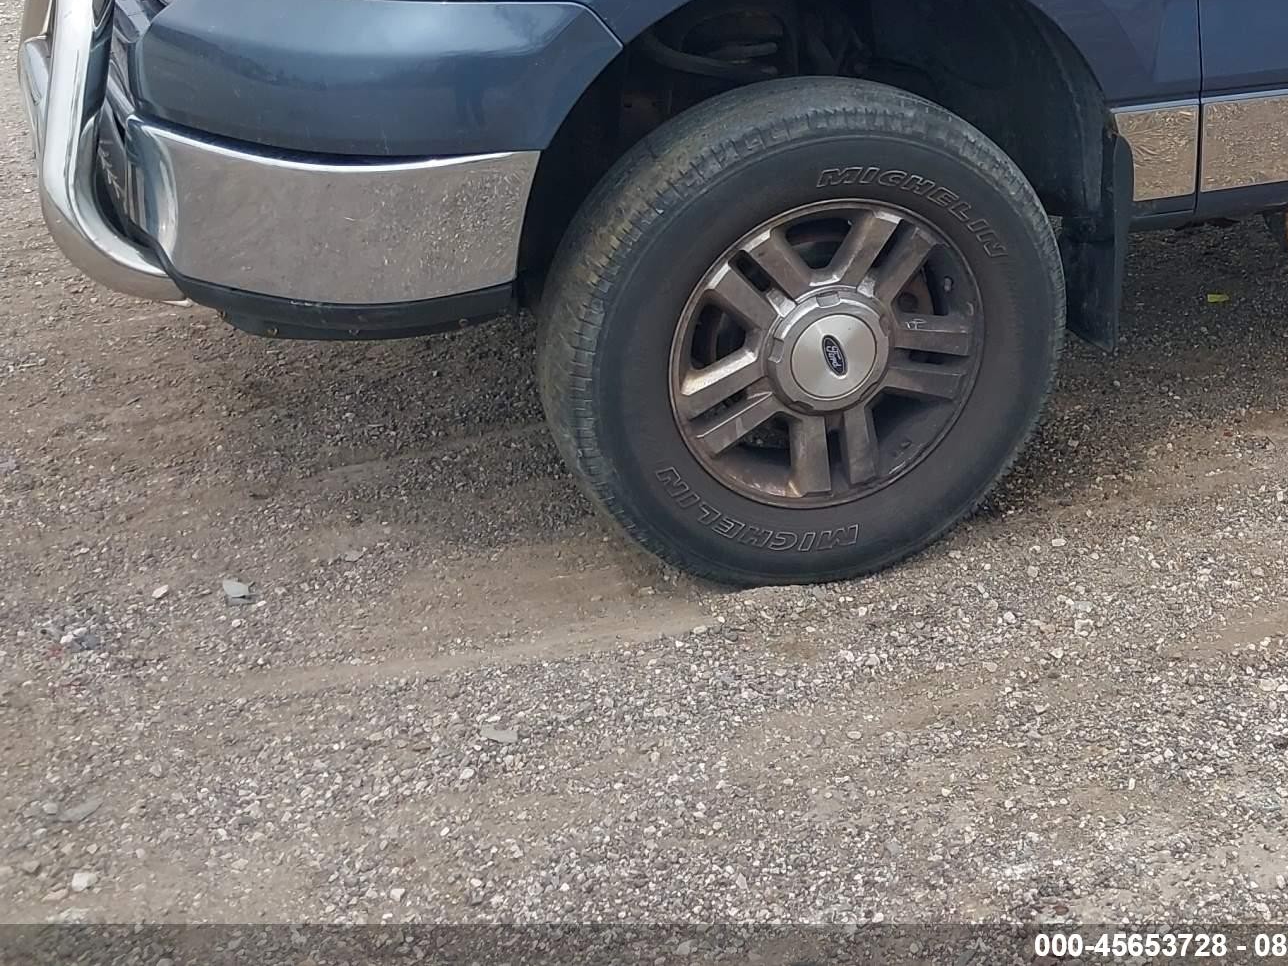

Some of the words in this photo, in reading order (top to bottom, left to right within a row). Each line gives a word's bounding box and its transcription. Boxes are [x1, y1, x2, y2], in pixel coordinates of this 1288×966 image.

[816, 165, 1009, 260] MICHELIN
[825, 344, 842, 369] Ford
[656, 465, 860, 553] MICHELIN
